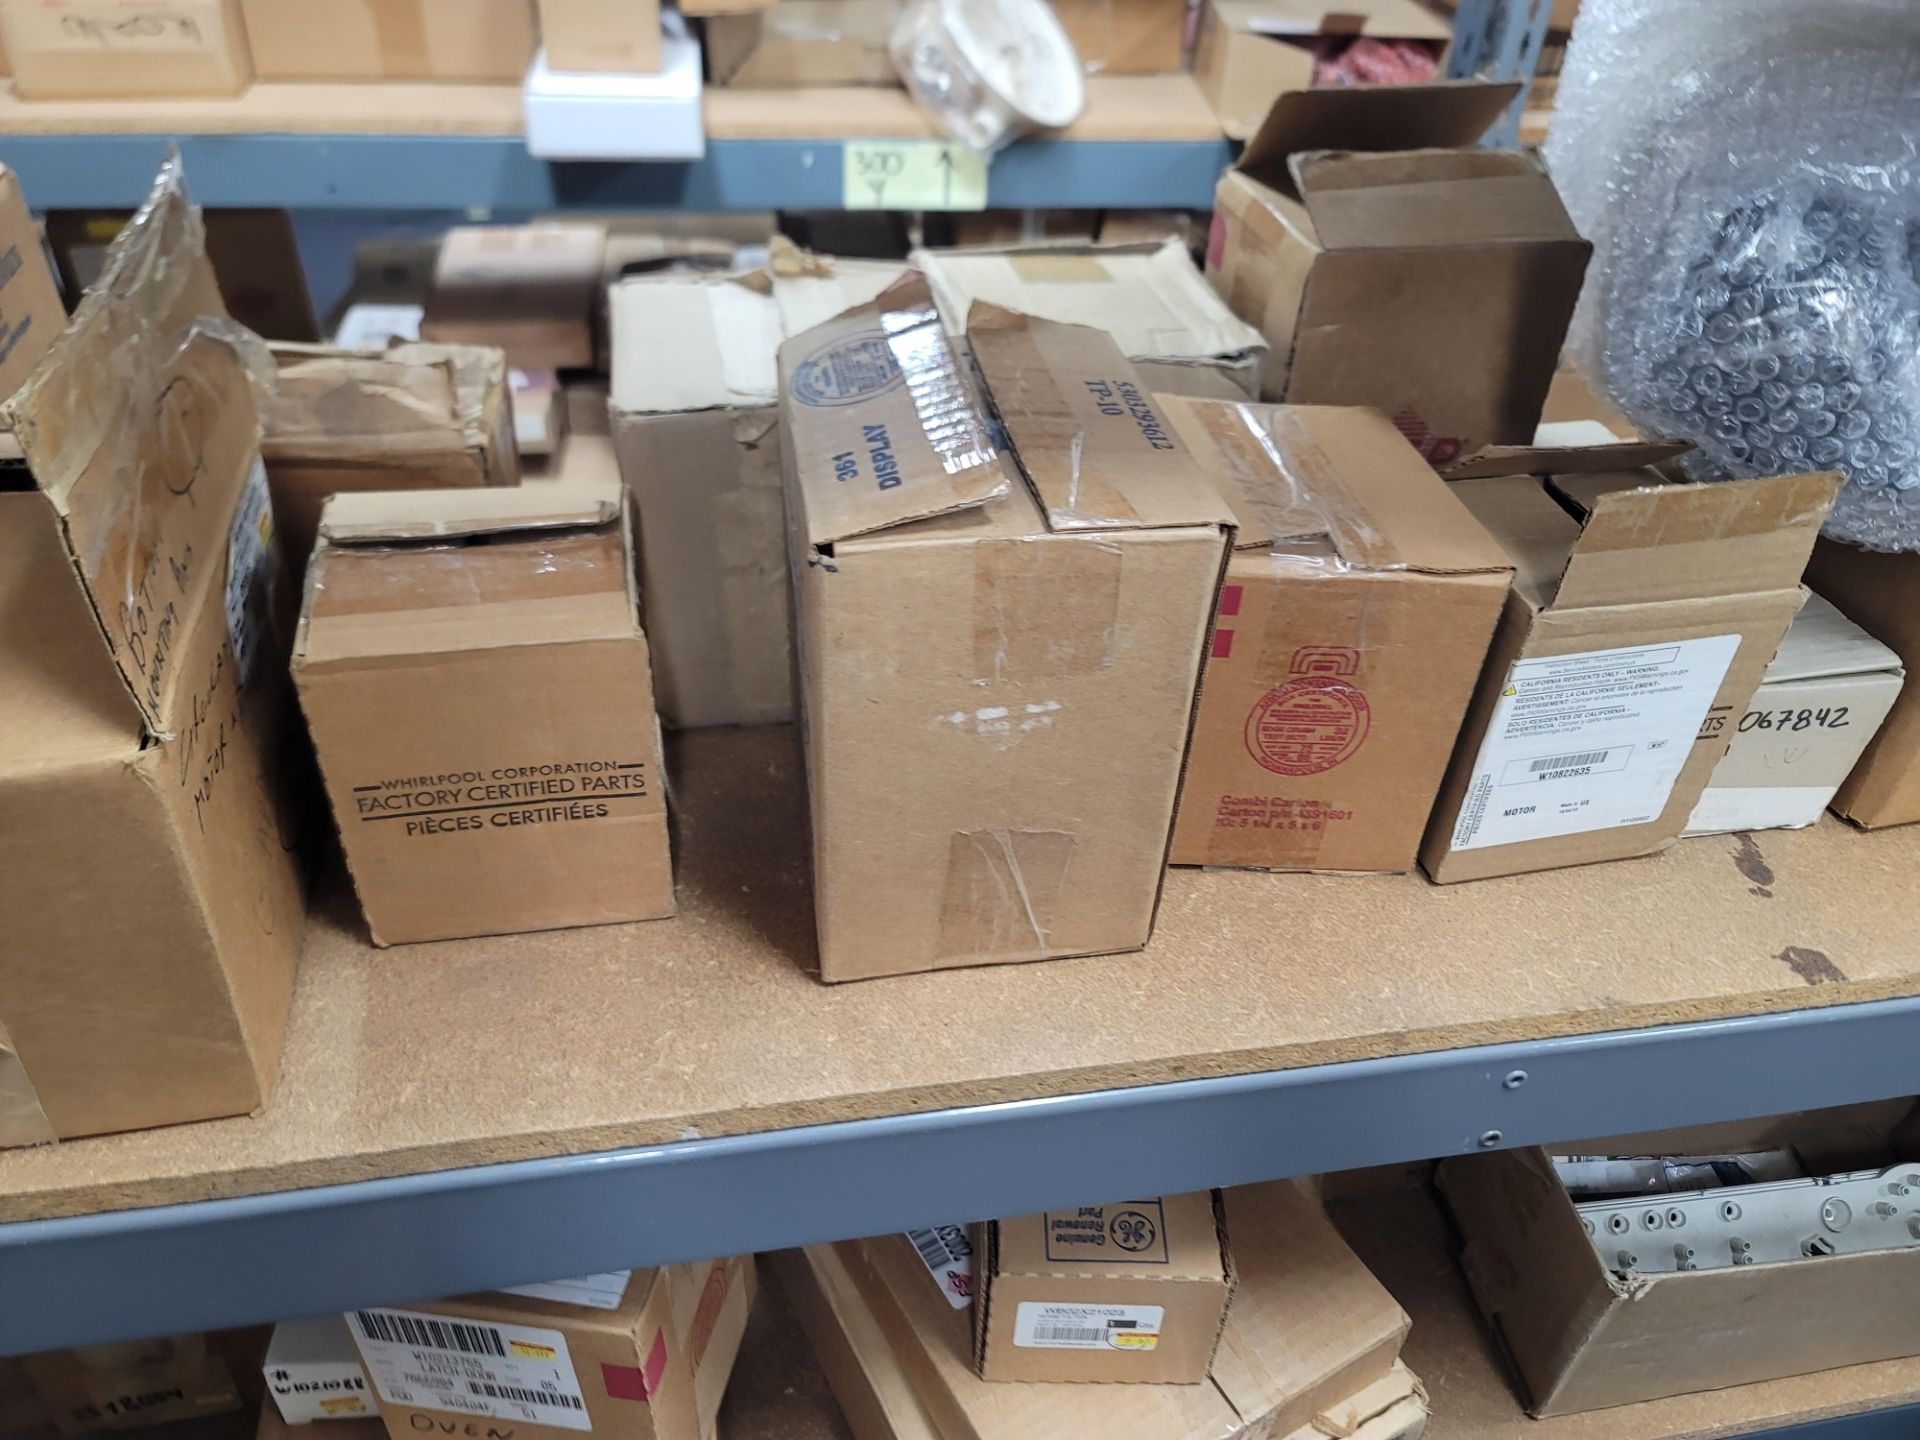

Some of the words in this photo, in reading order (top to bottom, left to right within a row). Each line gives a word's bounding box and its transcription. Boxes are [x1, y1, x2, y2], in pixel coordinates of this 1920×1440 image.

[863, 424, 902, 491] DISPLAY
[832, 451, 858, 482] 361
[1520, 678, 1561, 687] CALIFORNIA
[1563, 674, 1600, 683] RESIDENTS
[1515, 694, 1553, 703] RESIDENTS
[1508, 720, 1526, 728] SOLO
[1528, 715, 1572, 725] RESIDENTES
[1584, 708, 1626, 718] CALIFORNIA
[1737, 707, 1850, 732] 067842
[381, 771, 484, 790] WHIRLPOOL
[492, 761, 618, 780] CORPORATION
[1538, 766, 1591, 781] W10822635
[357, 787, 462, 813] FACTORY
[468, 778, 575, 801] CERTIFIED
[582, 774, 645, 791] PARTS
[1221, 795, 1268, 807] Combi
[1503, 805, 1536, 817] MOTOR
[406, 814, 483, 837] PIÈCES
[490, 803, 609, 827] CERTIFIÉES
[1052, 1220, 1104, 1232] Renewal
[1056, 1233, 1106, 1246] Genuine
